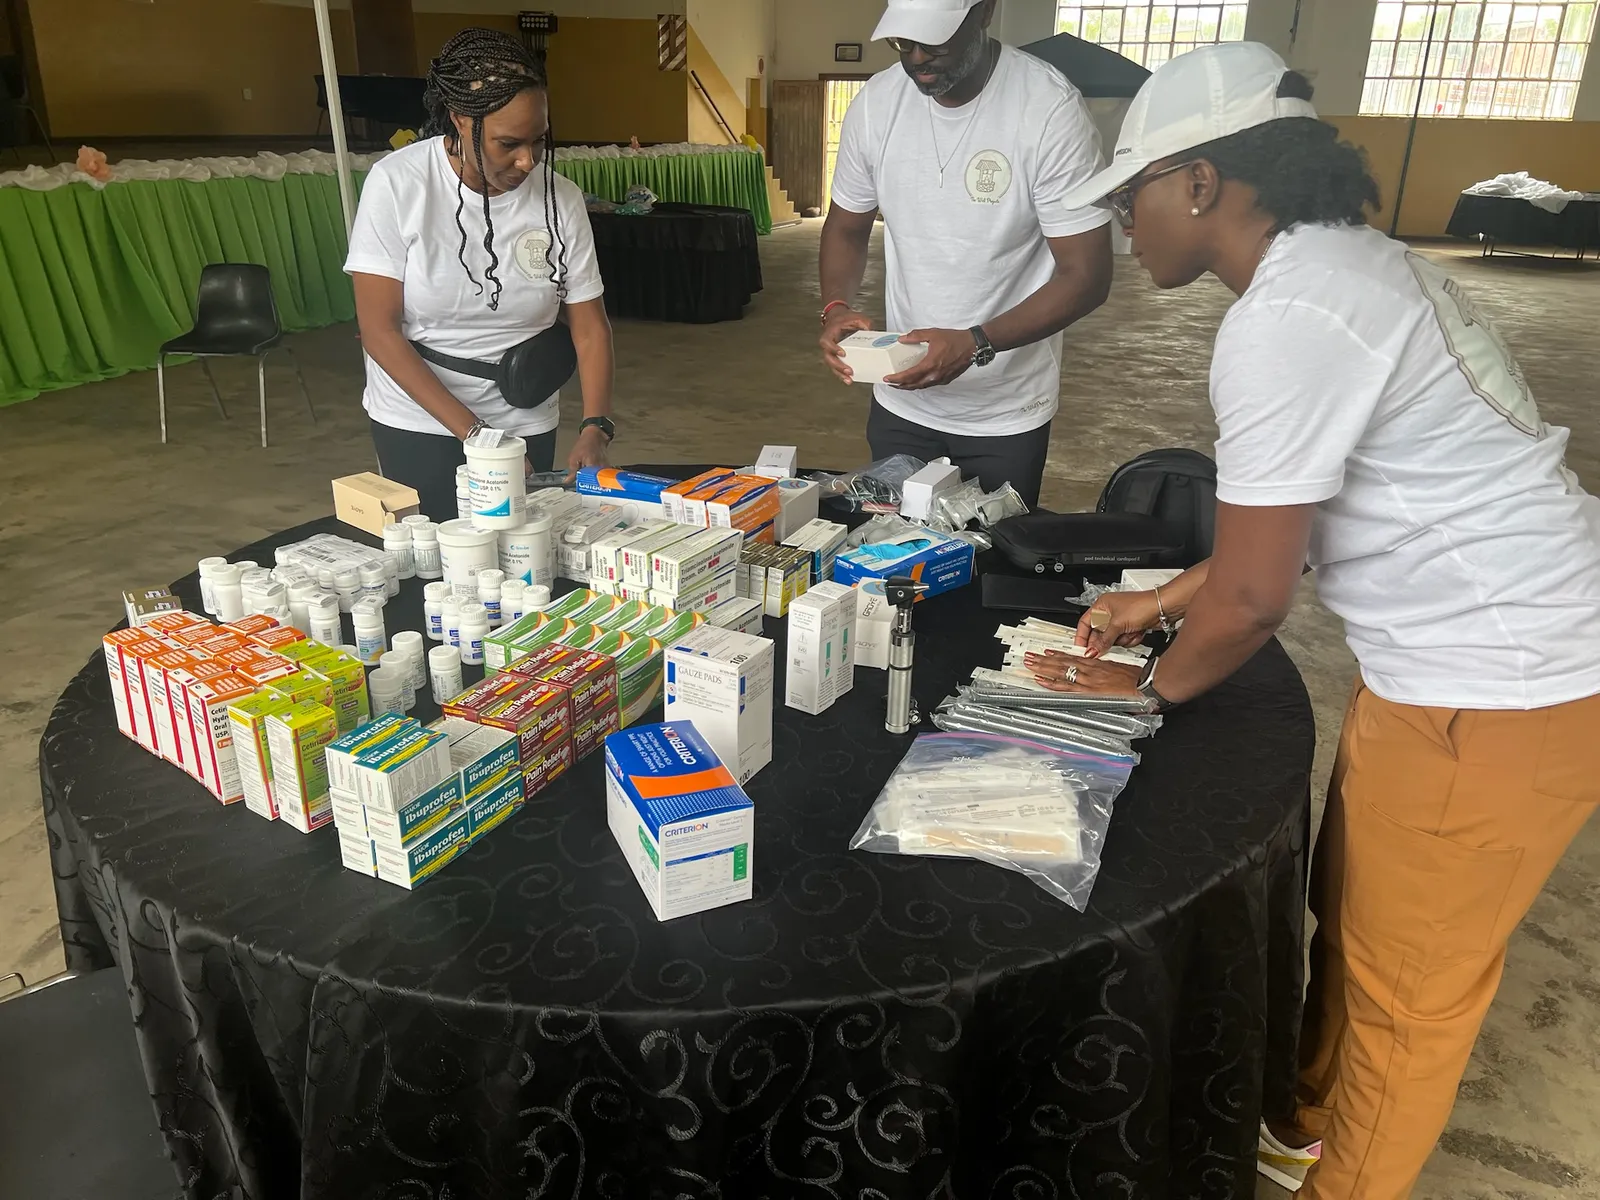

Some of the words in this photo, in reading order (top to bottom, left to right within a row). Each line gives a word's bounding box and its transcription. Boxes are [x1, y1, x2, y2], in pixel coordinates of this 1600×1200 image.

[513, 658, 535, 672] Pain
[551, 668, 571, 681] Pain
[566, 656, 587, 671] Relief
[678, 665, 703, 680] GAUZE
[703, 674, 722, 685] PADS
[730, 654, 748, 664] 100
[457, 692, 479, 706] Pain
[476, 680, 500, 695] Relief
[497, 704, 518, 719] Pain
[514, 689, 537, 706] Relief
[575, 690, 589, 706] Pain
[590, 675, 607, 696] Relief
[214, 722, 227, 731] Oral
[339, 716, 396, 748] Ibuprofen
[521, 726, 538, 743] Pain
[539, 708, 559, 731] Relief
[577, 729, 591, 746] Pain
[592, 713, 610, 735] Relief
[367, 731, 423, 764] Ibuprofen
[659, 726, 697, 766] CRITERION
[469, 749, 515, 784] Ibuprofen
[526, 767, 543, 784] Pain
[542, 748, 562, 772] Relief
[405, 787, 457, 825] Ibuprofen
[474, 786, 519, 822] Ibuprofen
[414, 826, 465, 866] Ibuprofen
[664, 822, 709, 838] CRITERION
